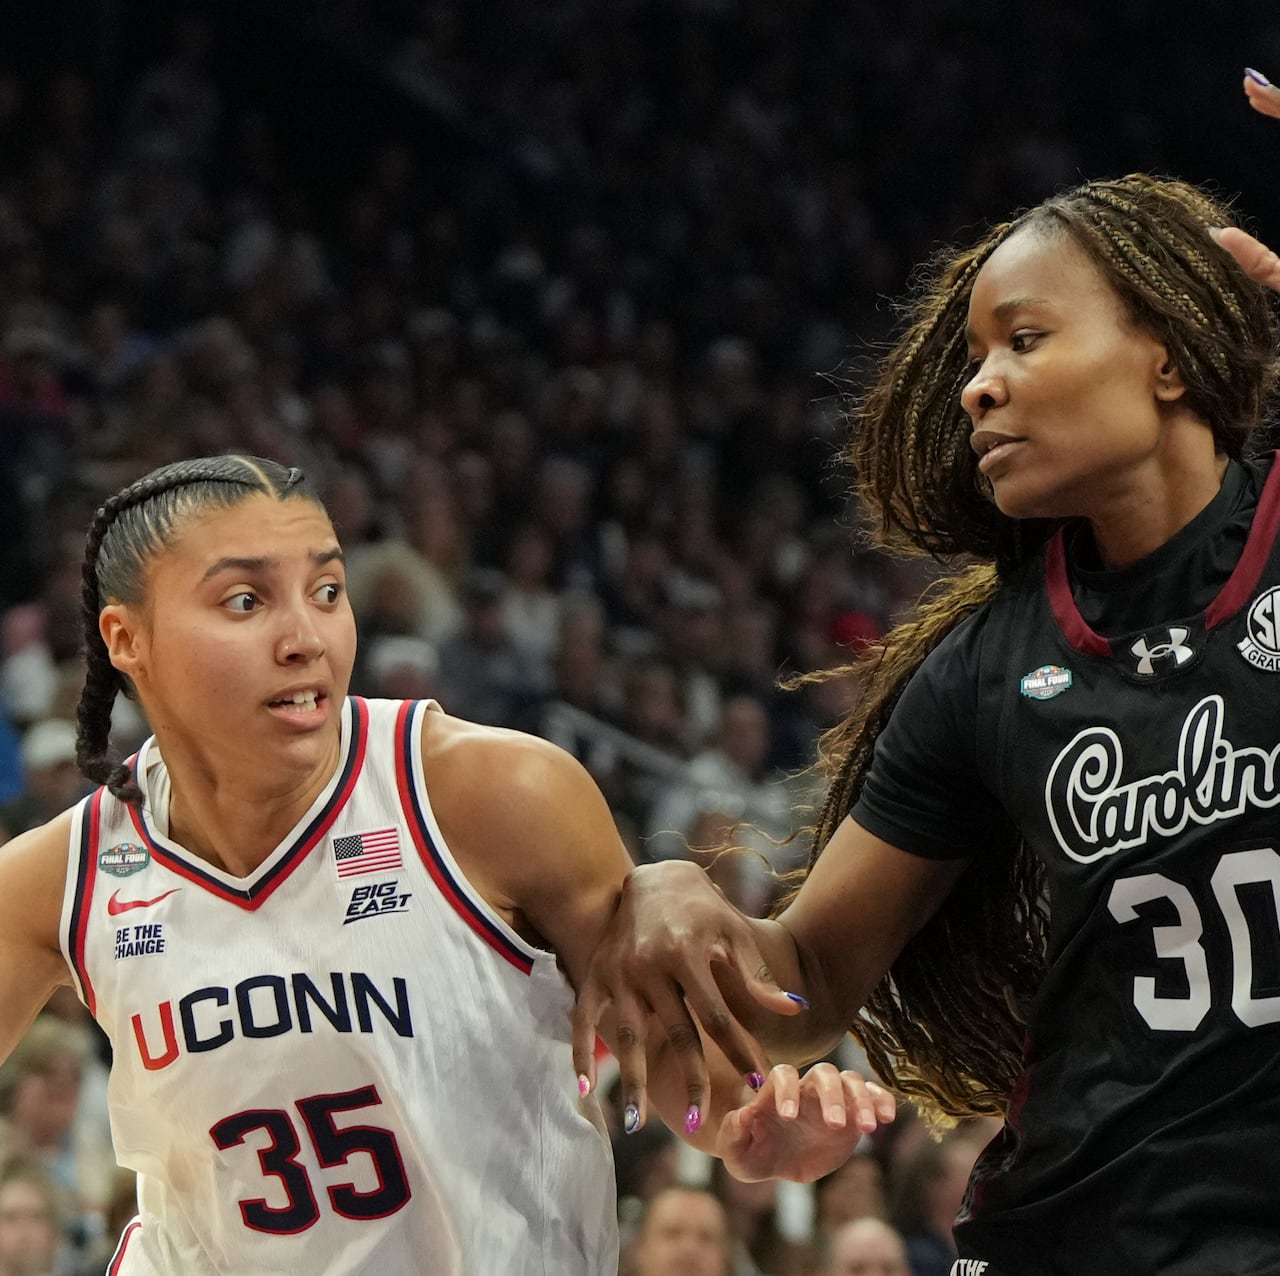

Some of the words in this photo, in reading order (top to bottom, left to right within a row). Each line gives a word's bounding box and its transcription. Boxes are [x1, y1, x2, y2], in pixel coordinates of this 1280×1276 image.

[1023, 677, 1047, 690] FINAL
[1047, 673, 1069, 686] FOUR
[101, 854, 124, 865] FINAL
[124, 852, 146, 864] FOUR
[351, 880, 398, 902] BIG
[346, 893, 412, 916] EAST
[116, 927, 130, 944] BE
[134, 924, 162, 941] THE
[131, 972, 414, 1071] UCONN
[208, 1084, 412, 1235] 35
